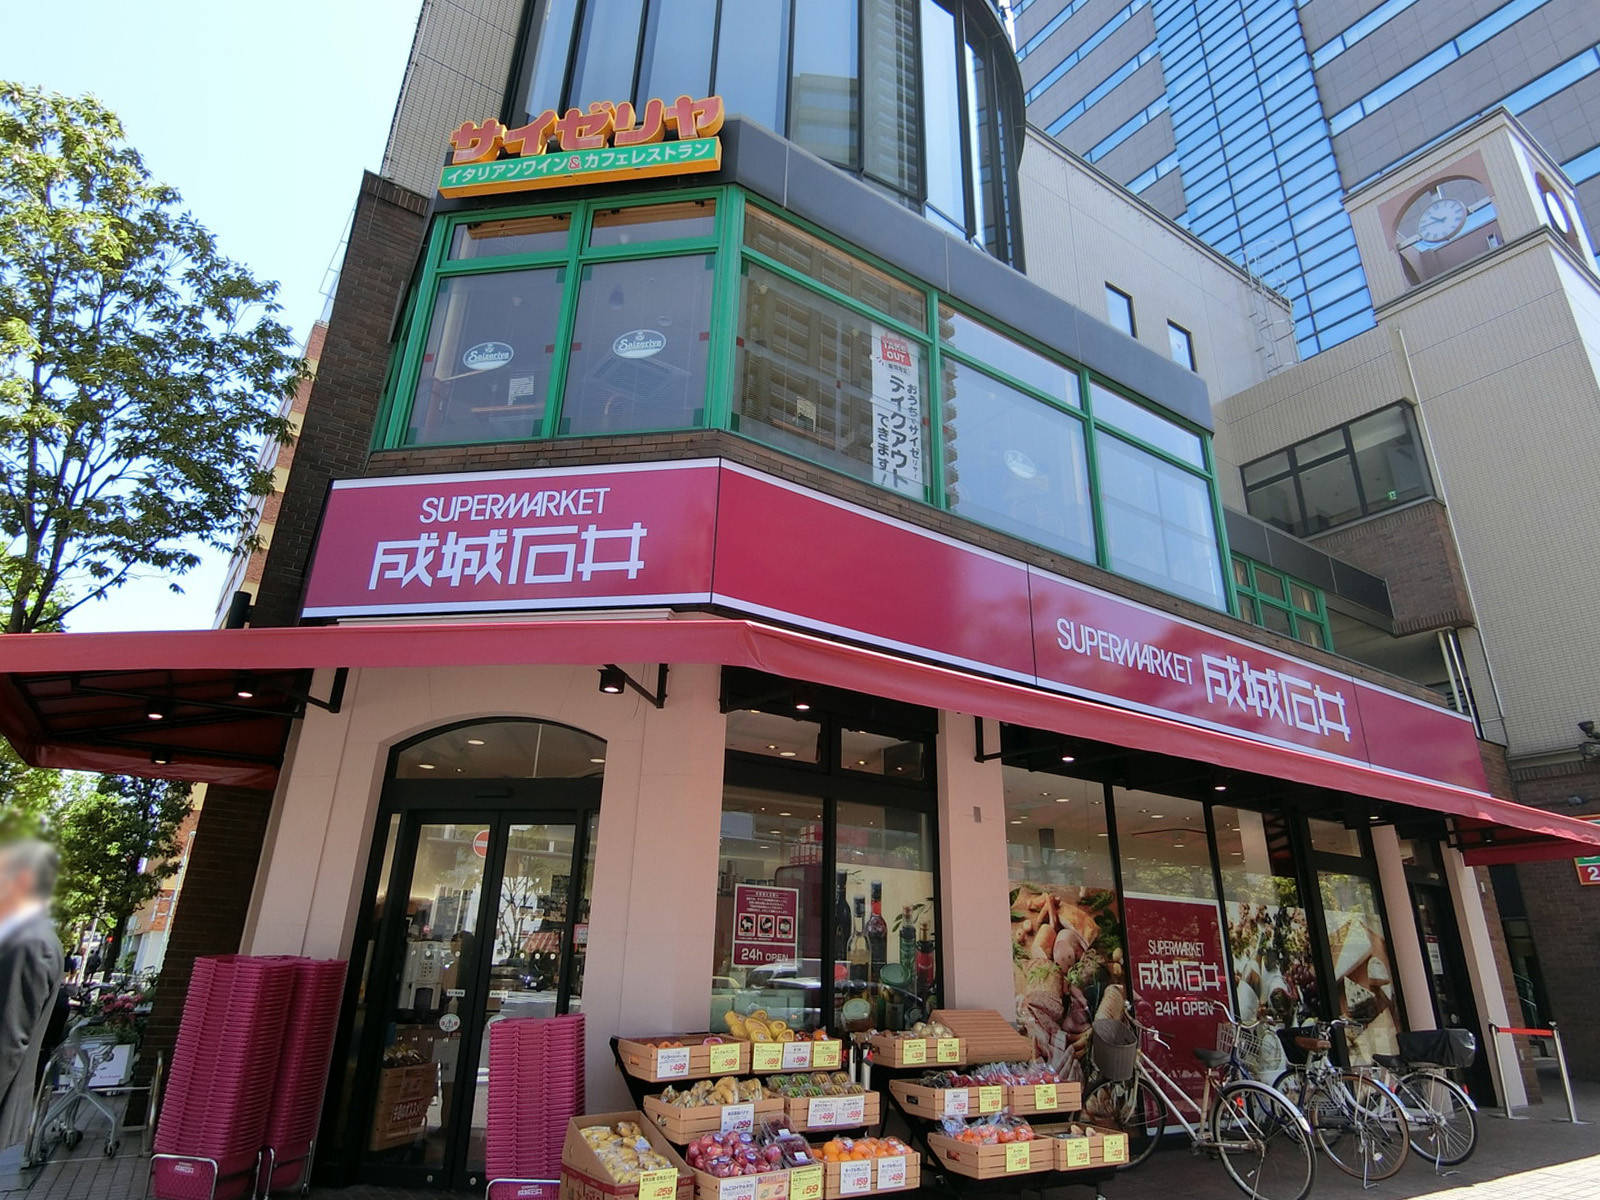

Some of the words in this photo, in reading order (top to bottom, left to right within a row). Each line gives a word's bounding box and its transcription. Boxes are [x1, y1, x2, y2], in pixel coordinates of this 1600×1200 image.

[450, 94, 726, 165] サイゼリヤ
[446, 142, 711, 185] イタリアンワイン&カフェレストラン
[886, 352, 906, 365] OUT
[419, 487, 611, 524] SUPERMARKET
[367, 521, 648, 591] 成城石井
[1056, 617, 1193, 685] SUPERMARKET
[1201, 652, 1351, 742] 成城石井
[741, 947, 763, 961] 24h
[765, 953, 789, 962] OPEN
[1148, 939, 1205, 957] SUPERMARKET
[1138, 959, 1221, 992] 成城石井
[1154, 1000, 1180, 1016] 24H
[1182, 1001, 1214, 1016] OPEN
